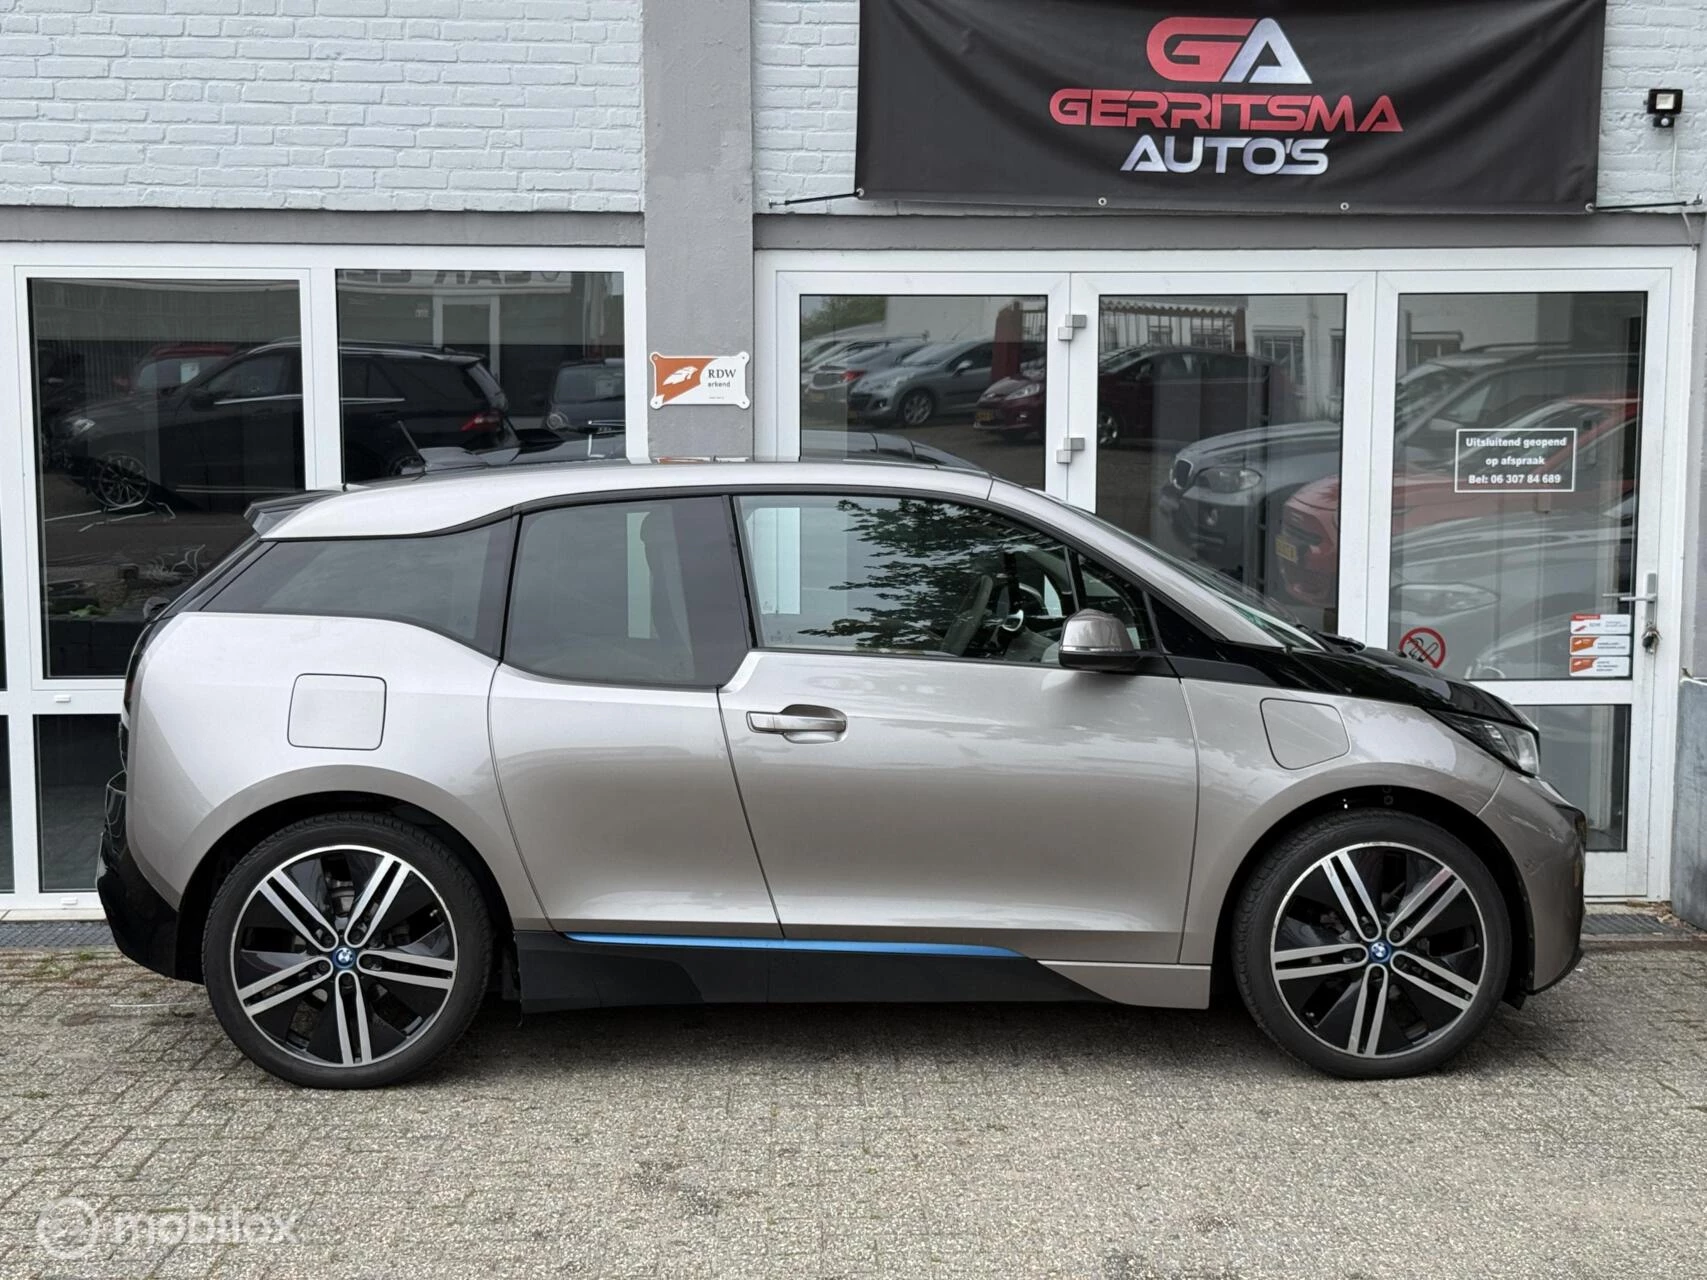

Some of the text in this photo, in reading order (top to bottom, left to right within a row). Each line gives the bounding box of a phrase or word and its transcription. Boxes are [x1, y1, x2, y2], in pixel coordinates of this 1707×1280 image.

[1146, 17, 1313, 85] GA
[1049, 88, 1405, 133] GERRITSMA
[1120, 134, 1330, 176] AUTO'S
[708, 368, 736, 378] RDW
[1465, 437, 1568, 449] Uitsluitend geopend
[1485, 455, 1546, 467] op afspraak
[1468, 474, 1562, 484] Bel: 06 307 84 689
